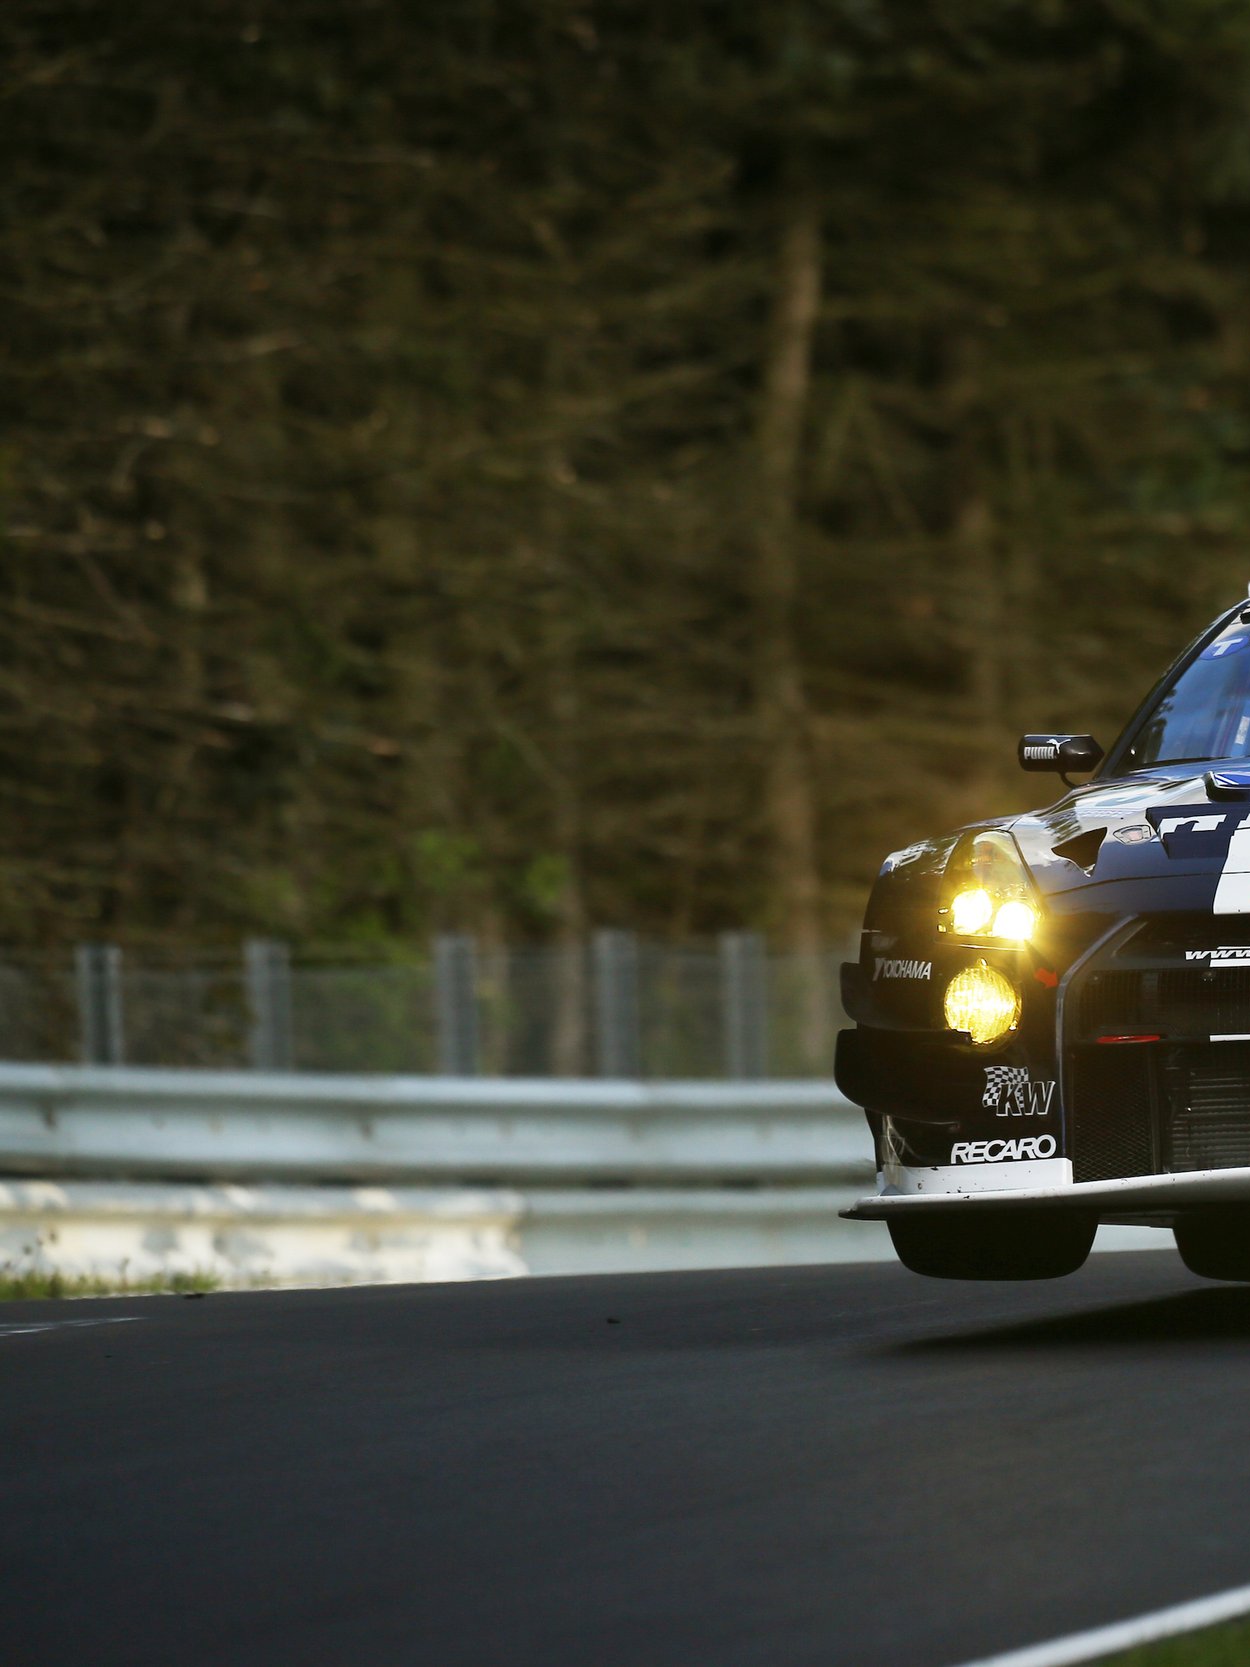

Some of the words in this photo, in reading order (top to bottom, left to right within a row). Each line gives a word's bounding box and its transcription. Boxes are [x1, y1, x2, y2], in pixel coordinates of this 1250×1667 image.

[1023, 746, 1057, 760] PUMA
[882, 958, 932, 980] YOKOHAMA
[996, 1080, 1055, 1117] KW
[951, 1134, 1056, 1164] RECARO
